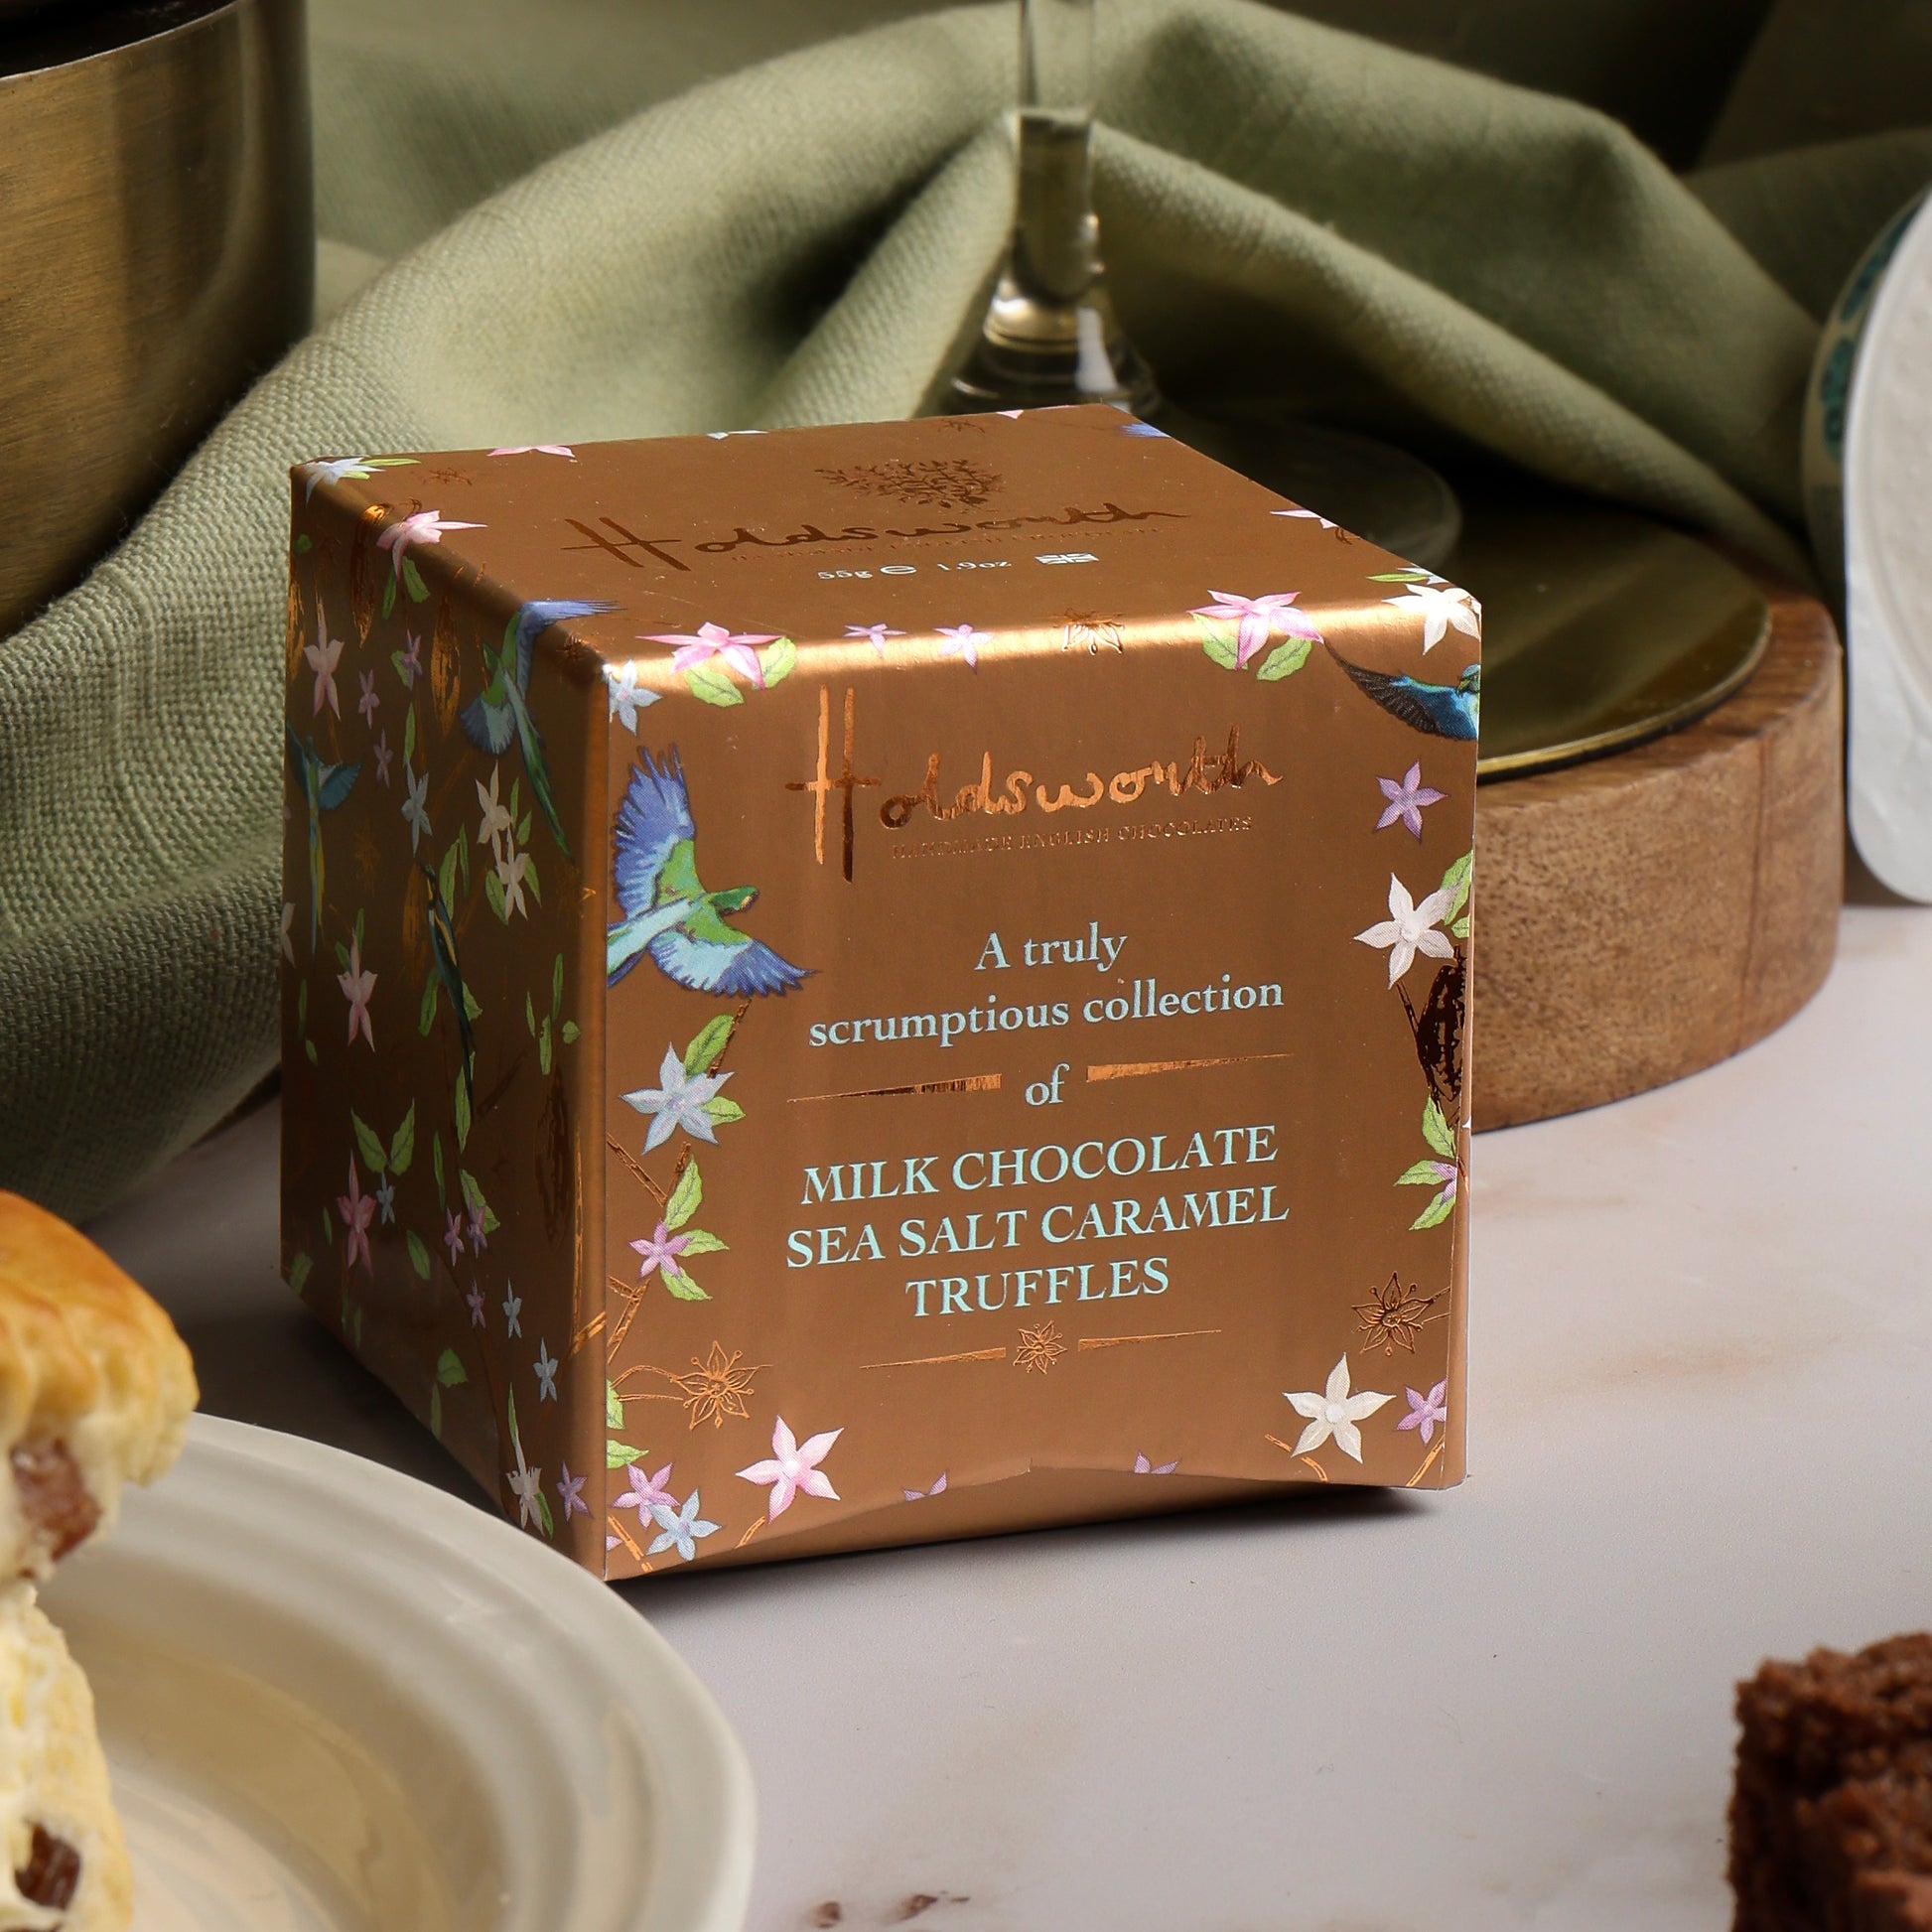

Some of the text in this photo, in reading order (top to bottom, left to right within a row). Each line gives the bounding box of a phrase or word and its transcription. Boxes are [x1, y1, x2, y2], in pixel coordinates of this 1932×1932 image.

[562, 502, 1189, 571] Holdsworth
[817, 570, 874, 581] 55g
[936, 561, 1012, 572] 1.9oz
[784, 684, 1283, 884] Holdsworth
[1020, 827, 1110, 851] ENGLISH
[1118, 816, 1253, 841] CHOCOLATES
[974, 921, 1128, 973] A truly
[808, 973, 1285, 1048] scrumptious collection
[1025, 1062, 1070, 1107] of
[800, 1124, 1279, 1205] MILK CHOCOLATE
[785, 1184, 1291, 1269] SEA SALT CARAMEL
[904, 1256, 1170, 1317] TRUFFLES
